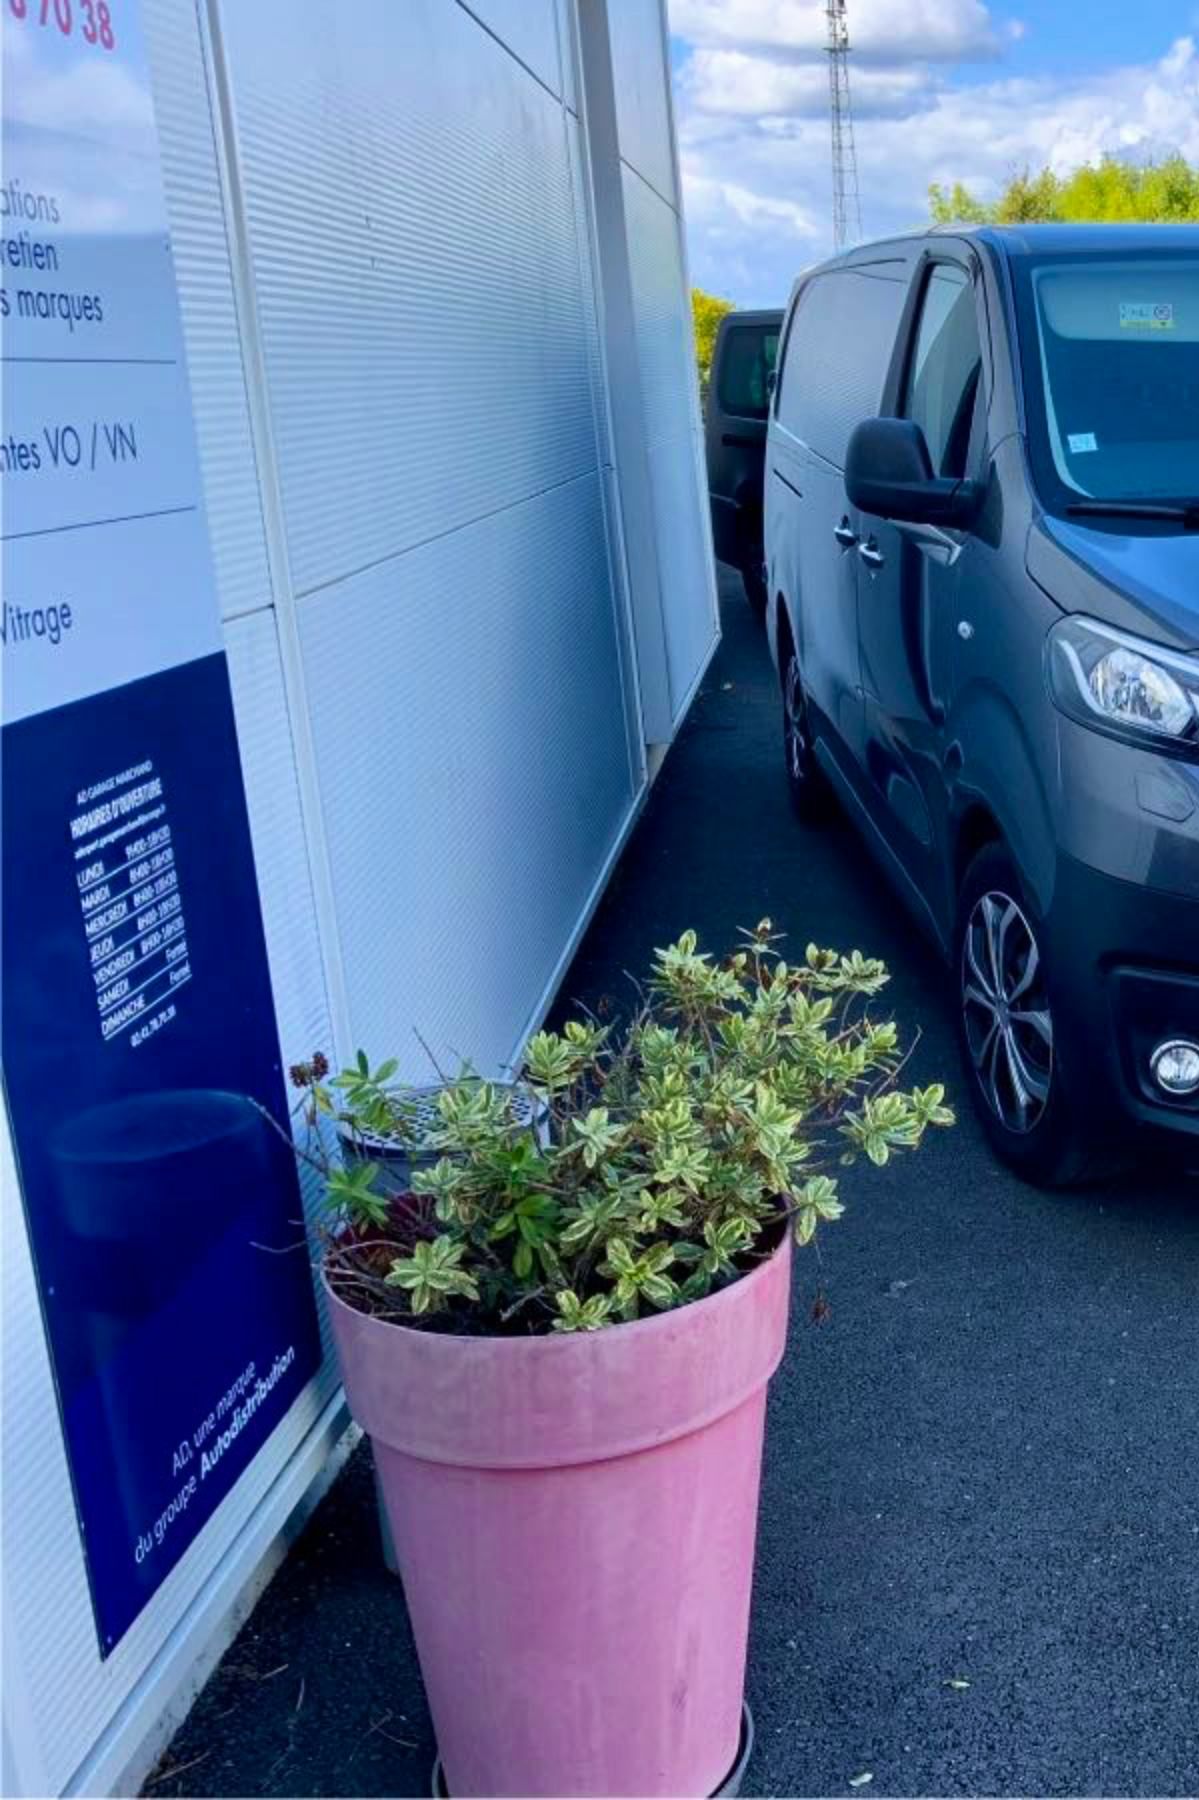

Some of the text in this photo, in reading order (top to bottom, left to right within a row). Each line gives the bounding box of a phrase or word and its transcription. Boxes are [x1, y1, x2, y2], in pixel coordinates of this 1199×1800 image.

[80, 0, 114, 50] 38
[0, 179, 59, 224] ations
[17, 290, 103, 332] marques
[44, 425, 81, 467] VO
[91, 421, 97, 470] /
[104, 422, 137, 461] VN
[76, 860, 104, 888] LUNDI
[81, 885, 111, 912] MARDI
[85, 901, 128, 936] MERCREDI
[90, 935, 114, 963] JEUDI
[93, 949, 135, 985] VENDREDI
[98, 978, 129, 1011] SAMEDI
[101, 994, 145, 1035] DIMANCHE
[193, 1412, 216, 1448] une
[216, 1360, 256, 1420] marque
[135, 1345, 295, 1564] du groupe Autodistribution
